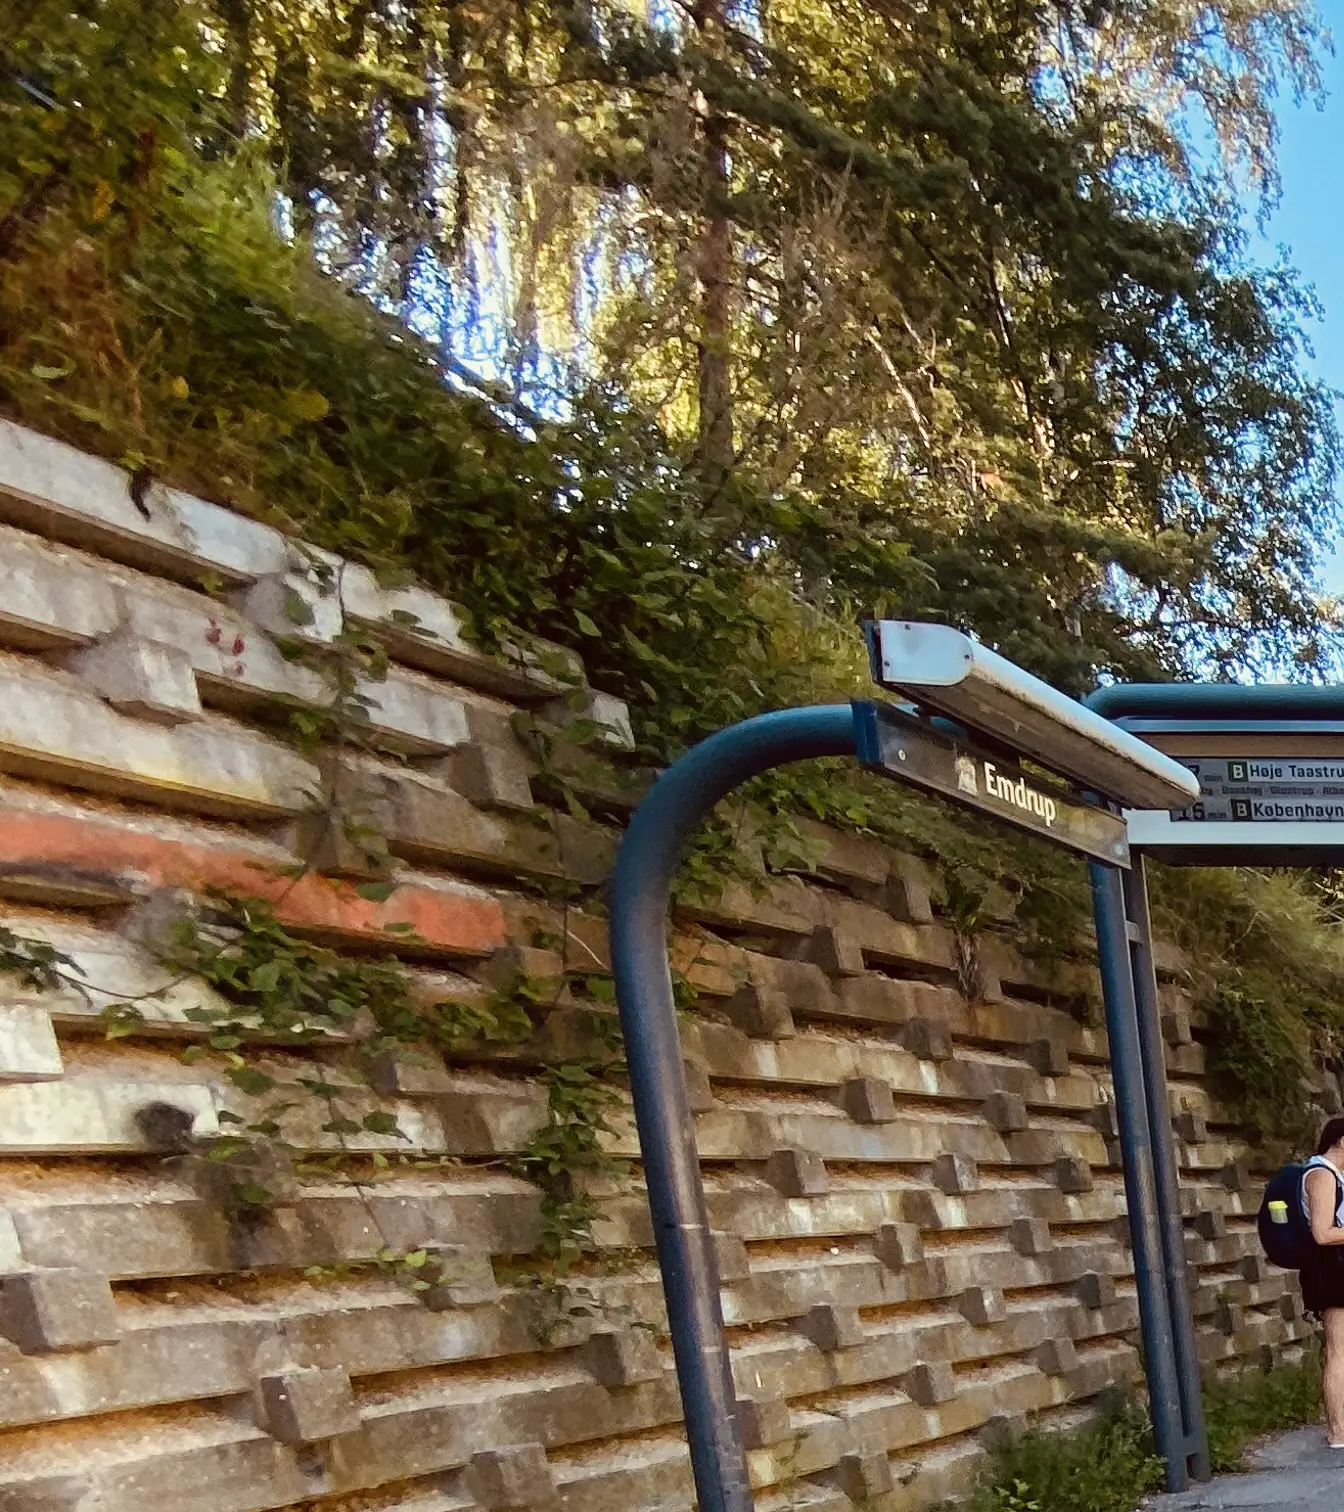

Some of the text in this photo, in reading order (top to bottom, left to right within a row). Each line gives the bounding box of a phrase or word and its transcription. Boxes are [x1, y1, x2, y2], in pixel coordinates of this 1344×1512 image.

[1232, 764, 1244, 779] B
[984, 761, 1056, 827] Emdrup
[1237, 803, 1247, 817] B
